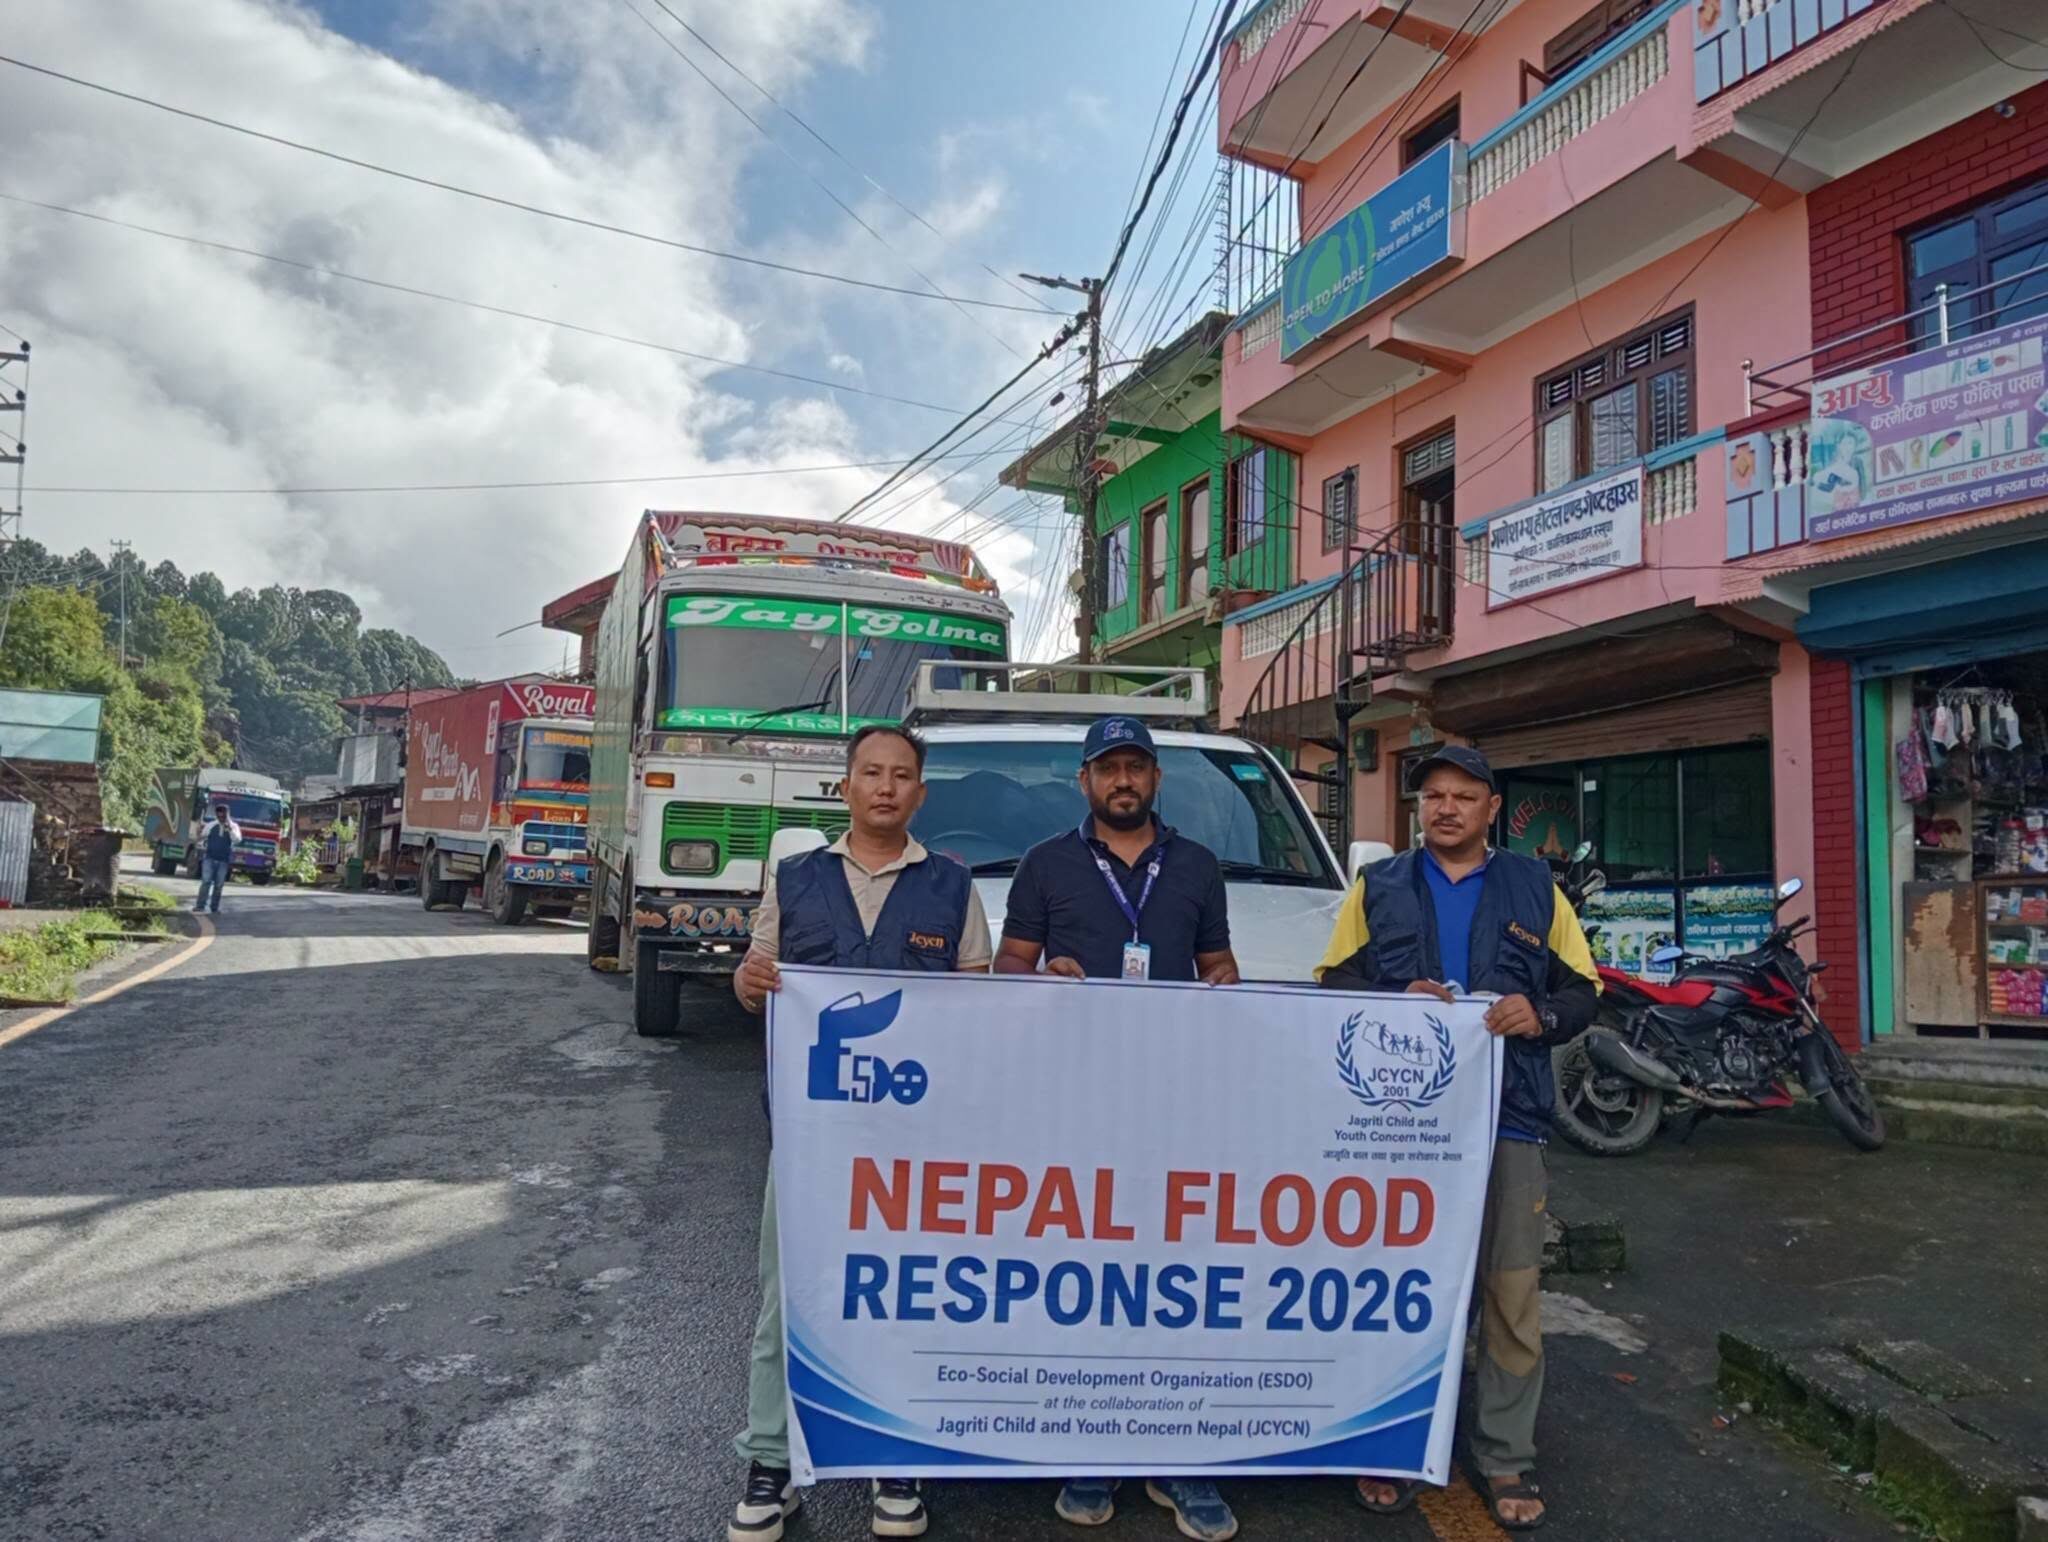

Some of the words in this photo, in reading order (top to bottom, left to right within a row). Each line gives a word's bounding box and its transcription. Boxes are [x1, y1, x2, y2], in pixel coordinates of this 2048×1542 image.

[1286, 299, 1313, 329] OPEN
[1315, 289, 1331, 305] TO
[1332, 265, 1365, 299] MORE
[1817, 371, 1893, 416] आयु
[1931, 394, 1959, 414] एण्ड
[2008, 370, 2045, 394] पसल
[1490, 520, 1518, 549] गणेश
[1535, 505, 1562, 535] होटल
[1606, 478, 1639, 513] हाउस
[851, 608, 1001, 647] Golma
[523, 684, 590, 719] Royal
[513, 866, 555, 881] ROAD
[1368, 1068, 1424, 1084] JCYCN
[1383, 1086, 1409, 1097] 2001
[1348, 1115, 1383, 1129] Jagriti
[1386, 1116, 1414, 1127] Child
[1417, 1117, 1438, 1128] and
[1334, 1130, 1366, 1142] Youth
[1369, 1131, 1416, 1143] Concern
[1419, 1133, 1451, 1145] Nepal
[848, 1157, 1135, 1242] NEPAL
[1163, 1170, 1435, 1247] FLOOD
[842, 1253, 1244, 1330] RESPONSE
[1266, 1266, 1433, 1334] 2026
[937, 1365, 1028, 1384] Eco-Social
[1036, 1368, 1145, 1390] Development
[1150, 1370, 1253, 1390] Organization
[1258, 1372, 1313, 1390] (ESDO)
[1044, 1398, 1058, 1409] at
[1062, 1396, 1086, 1410] the
[1090, 1396, 1184, 1411] collaboration
[1188, 1397, 1205, 1411] of
[936, 1416, 988, 1437] Jagriti
[993, 1416, 1036, 1433] Child
[1041, 1418, 1071, 1434] and
[1076, 1418, 1121, 1435] Youth
[1126, 1419, 1192, 1436] Concern
[1198, 1420, 1242, 1439] Nepal
[1247, 1419, 1311, 1439] (JCYCN)
